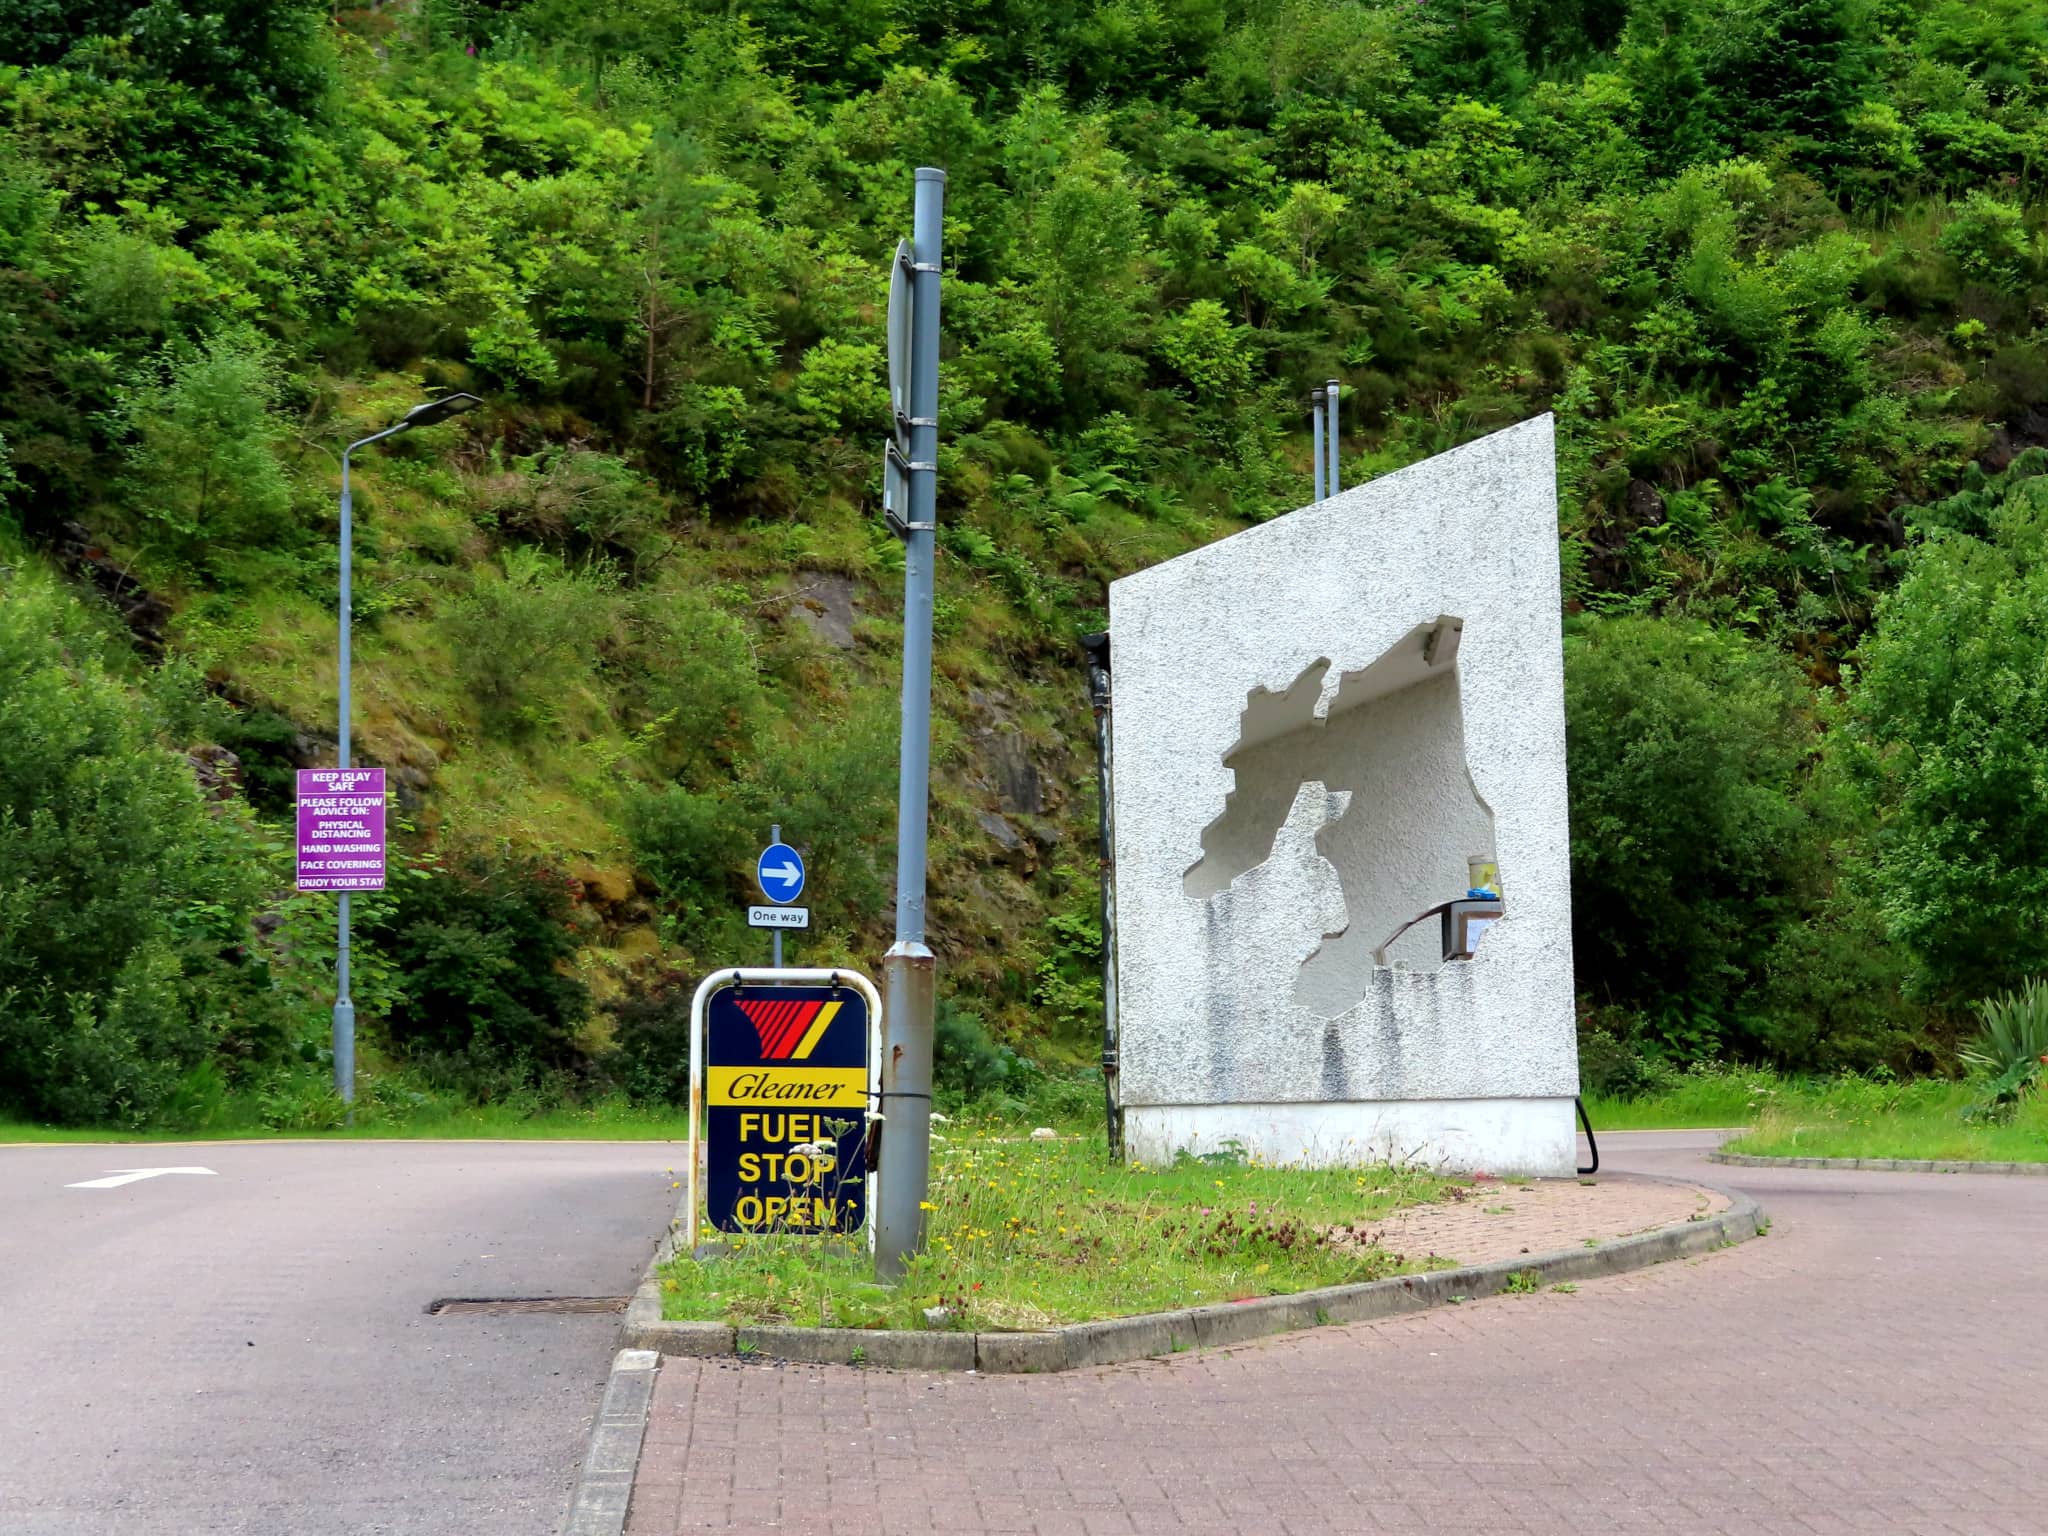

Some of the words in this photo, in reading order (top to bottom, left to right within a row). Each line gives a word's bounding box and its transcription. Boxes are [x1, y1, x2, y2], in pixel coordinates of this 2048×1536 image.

[312, 773, 339, 782] KEEP
[341, 772, 371, 782] ISLAY
[328, 782, 355, 791] SAFE
[300, 798, 337, 807] PLEASE
[340, 798, 383, 807] FOLLOW
[313, 807, 349, 816] ADVICE
[351, 807, 370, 815] ON:
[319, 821, 364, 829] PHYSICAL
[312, 829, 371, 838] DISTANCING
[302, 845, 331, 853] HAND
[333, 844, 381, 853] WASHING
[300, 861, 325, 869] FACE
[326, 860, 382, 869] COVERINGS
[299, 878, 329, 887] ENJOY
[331, 878, 358, 887] YOUR
[359, 878, 384, 886] STAY
[753, 911, 777, 921] One
[780, 914, 804, 923] way
[728, 1073, 846, 1100] Gleaner
[739, 1113, 833, 1143] FUEL
[738, 1152, 835, 1183] STOP
[736, 1195, 837, 1227] OPEN
